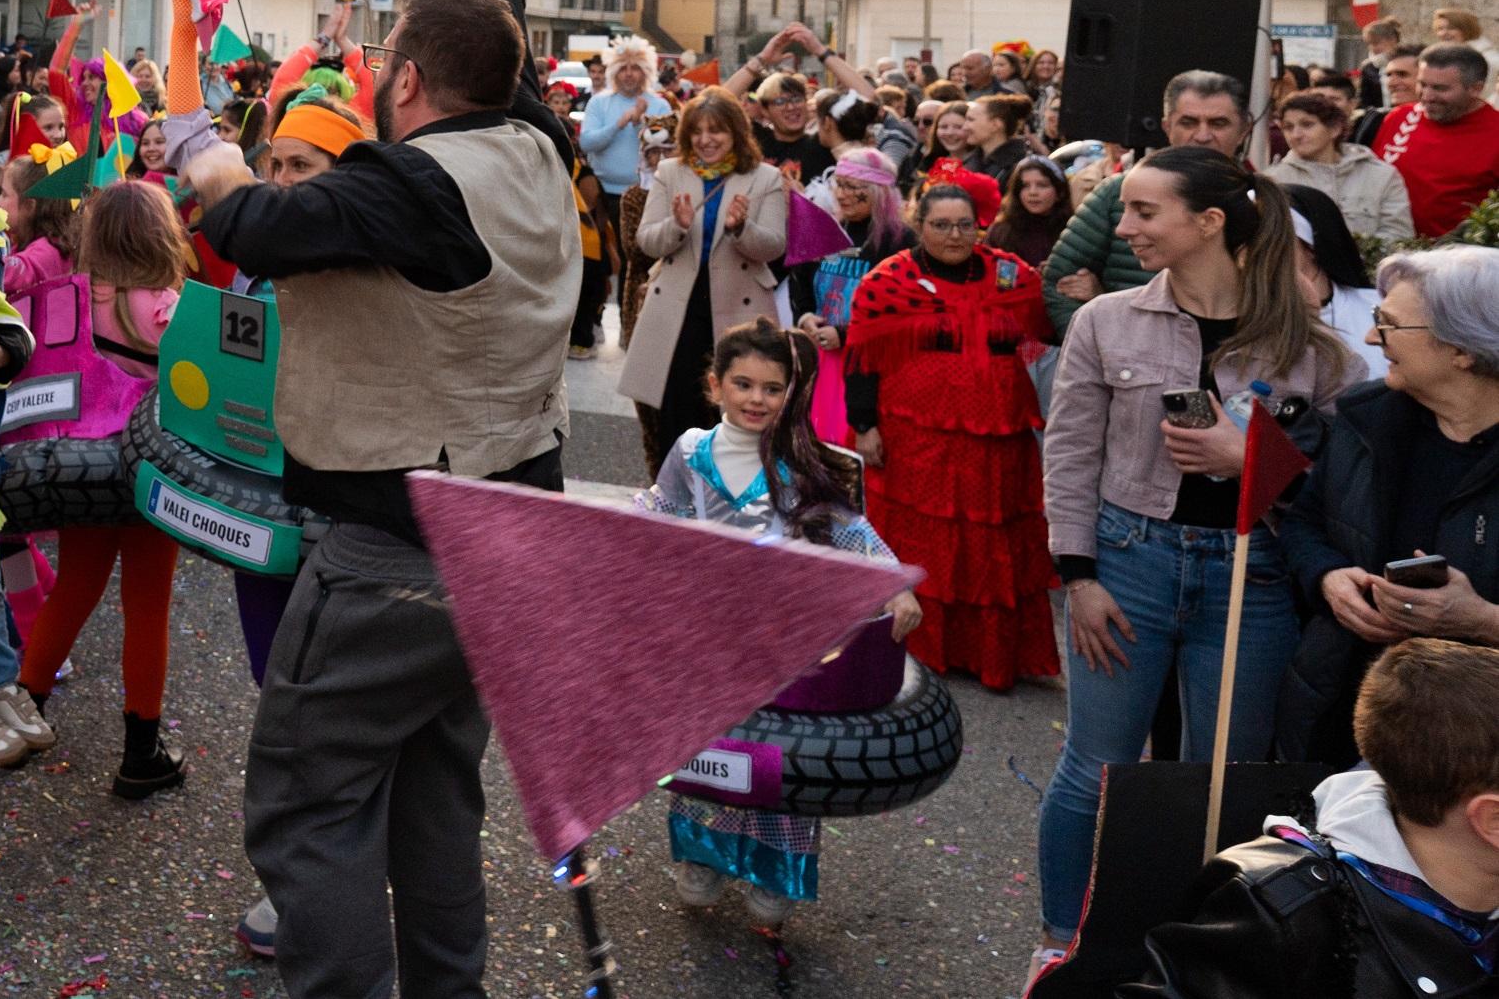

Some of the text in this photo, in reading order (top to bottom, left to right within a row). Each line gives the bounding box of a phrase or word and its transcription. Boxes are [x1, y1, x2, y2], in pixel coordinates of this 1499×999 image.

[225, 310, 259, 348] 12
[163, 496, 251, 549] VALEI CHOQUES
